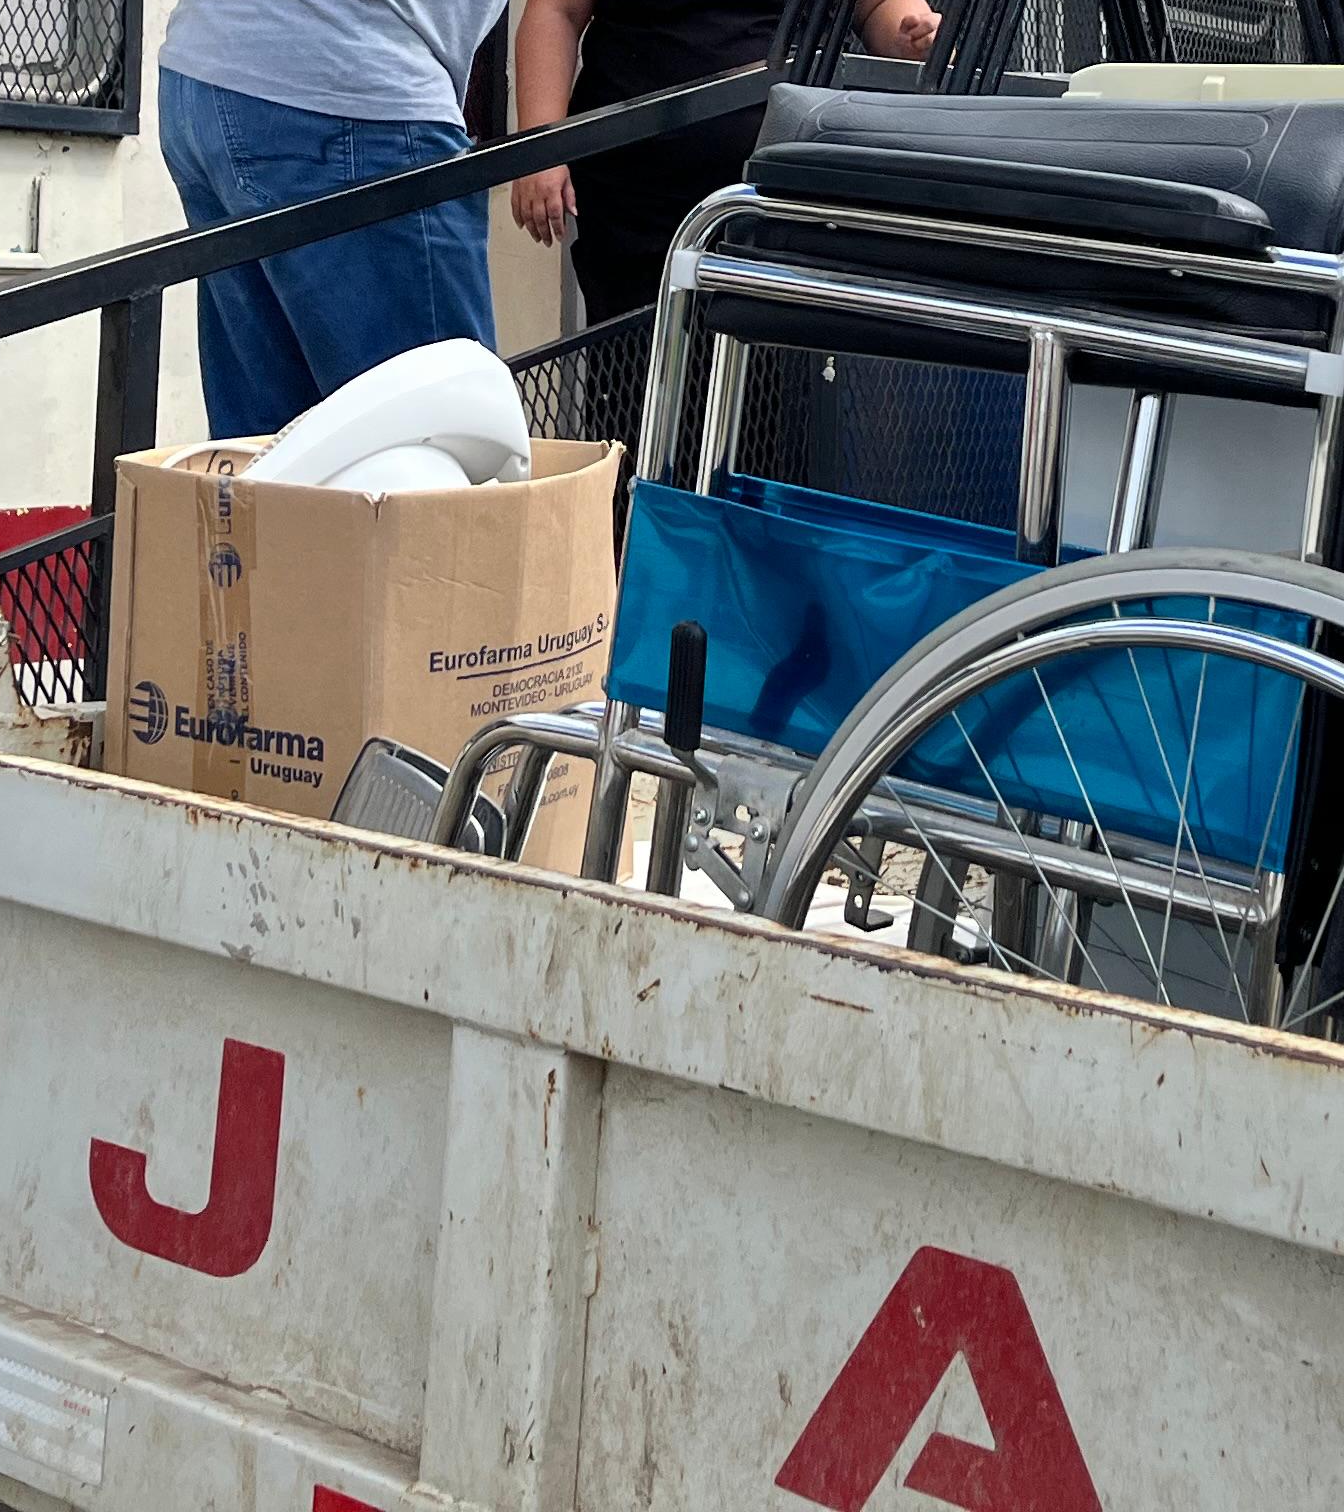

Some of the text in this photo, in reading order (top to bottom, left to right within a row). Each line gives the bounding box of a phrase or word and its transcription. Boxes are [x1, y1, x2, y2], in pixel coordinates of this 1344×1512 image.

[238, 631, 249, 702] CONTENIDO
[429, 642, 532, 673] Eurofarma
[538, 622, 594, 655] Uruguay
[470, 688, 547, 717] MONTEVIDEO
[554, 671, 594, 697] URUGUAY
[492, 669, 565, 698] DEMOCRACIA
[175, 705, 324, 762] Eurofarma
[250, 757, 323, 788] Uruguay
[89, 1038, 1103, 1512] J A
